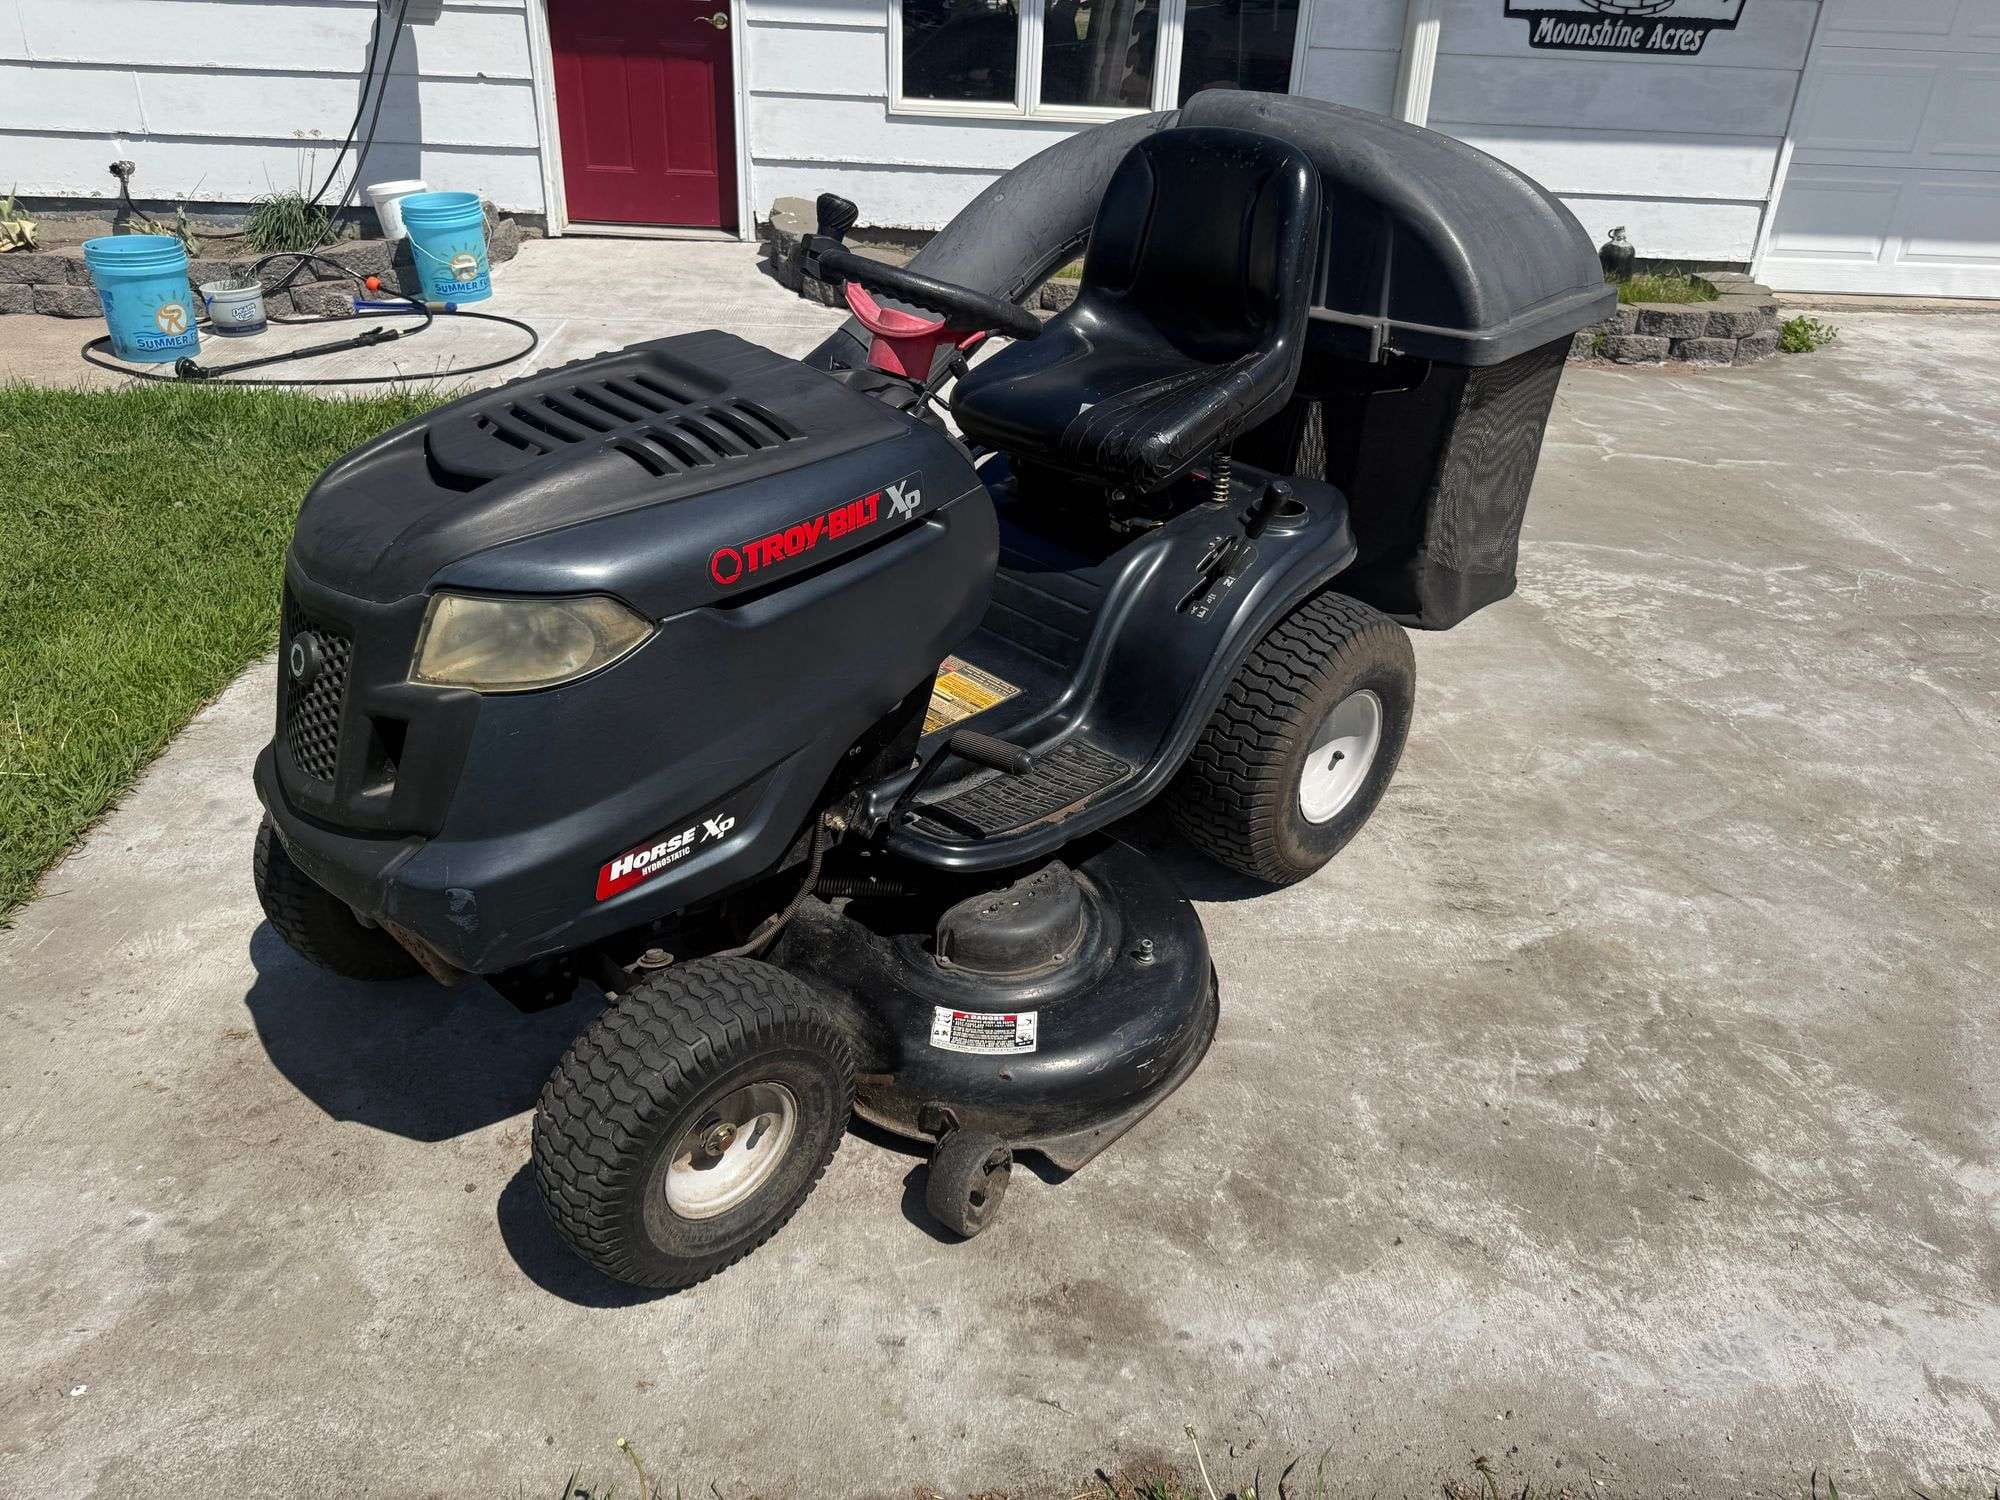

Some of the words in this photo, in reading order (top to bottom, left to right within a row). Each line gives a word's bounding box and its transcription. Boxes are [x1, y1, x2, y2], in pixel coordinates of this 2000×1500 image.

[1533, 17, 1641, 47] Moonshine
[1646, 23, 1704, 50] Acres
[435, 281, 478, 292] SUMMER
[136, 335, 188, 349] SUMMER
[609, 826, 697, 882] HORSE
[641, 846, 691, 877] HYDROSTATIC
